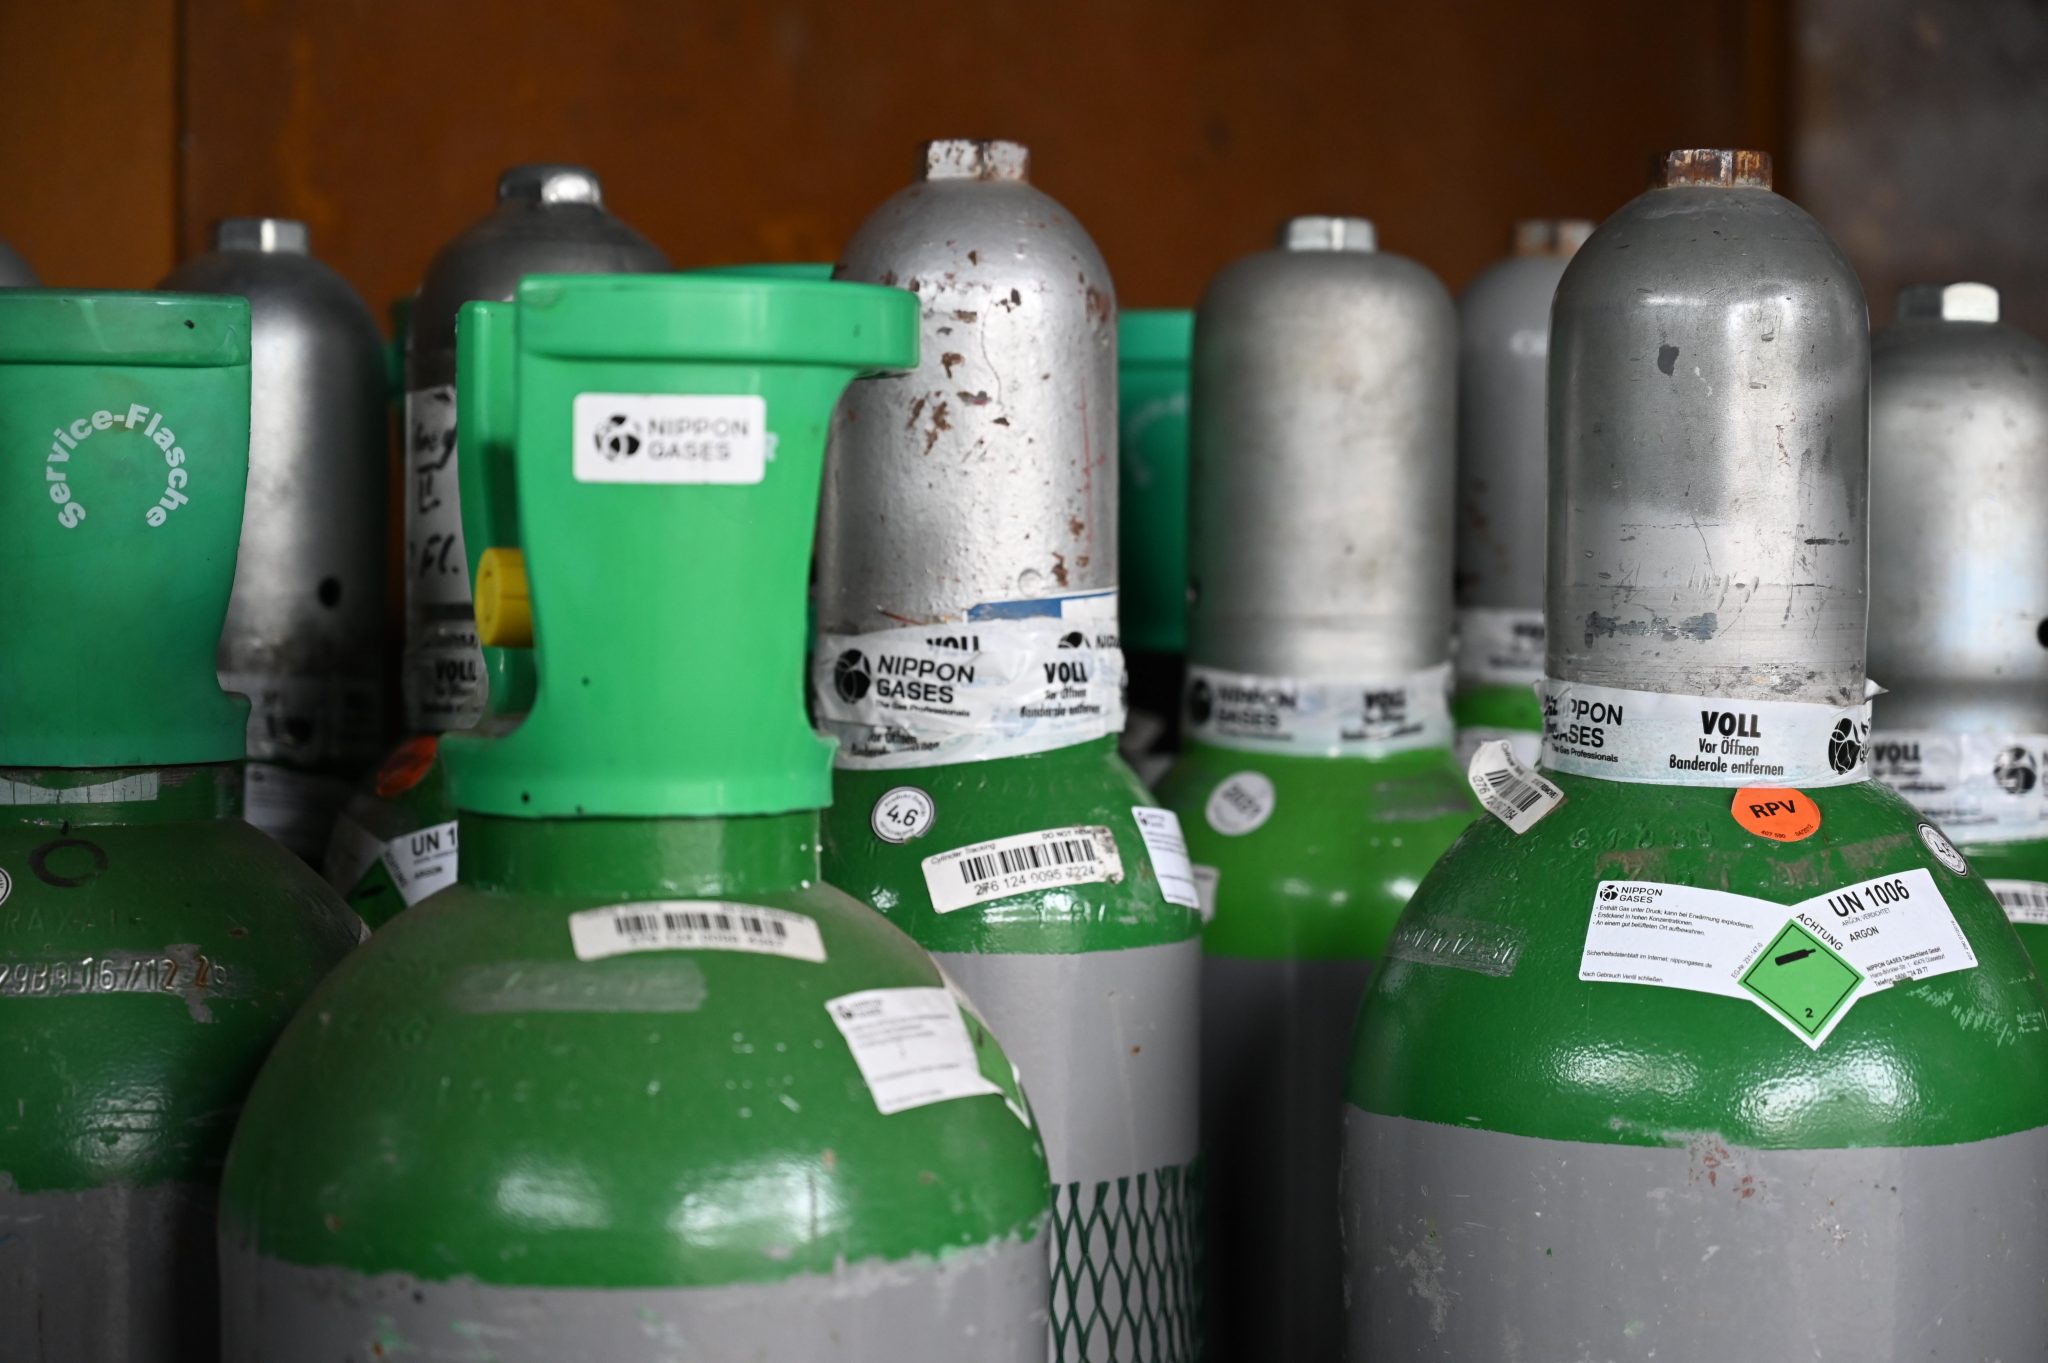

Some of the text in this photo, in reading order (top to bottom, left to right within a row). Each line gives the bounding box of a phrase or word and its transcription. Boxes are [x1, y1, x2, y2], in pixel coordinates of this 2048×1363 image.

[648, 418, 749, 437] NIPPON
[648, 441, 731, 461] GASES
[46, 403, 189, 529] Service-Flasche
[877, 655, 976, 684] NIPPON
[1043, 662, 1088, 684] VOLL
[876, 679, 954, 704] GASES
[1701, 710, 1762, 738] VOLL
[1559, 746, 1570, 755] Gas
[1570, 747, 1618, 762] Professionals
[1698, 736, 1760, 757] Vor Öffnen
[1874, 744, 1920, 763] VOLL
[1669, 755, 1784, 777] Banderole entfernen
[887, 805, 919, 827] 4.6
[1749, 800, 1796, 820] RPV
[411, 831, 440, 856] UN
[931, 850, 962, 865] Cylinder
[1004, 875, 1027, 889] 124
[1621, 886, 1663, 896] NIPPON
[1620, 894, 1653, 903] GASES
[1828, 879, 1910, 918] UN 1006
[1796, 912, 1843, 951] ACHTUNG
[1849, 926, 1880, 942] ARGON
[1586, 950, 1639, 959] Sicherheitsdatenblatt
[1866, 960, 1886, 972] NIPPON
[1885, 956, 1903, 966] GASES
[1902, 949, 1929, 960] Deutschland
[1805, 1008, 1814, 1018] 2
